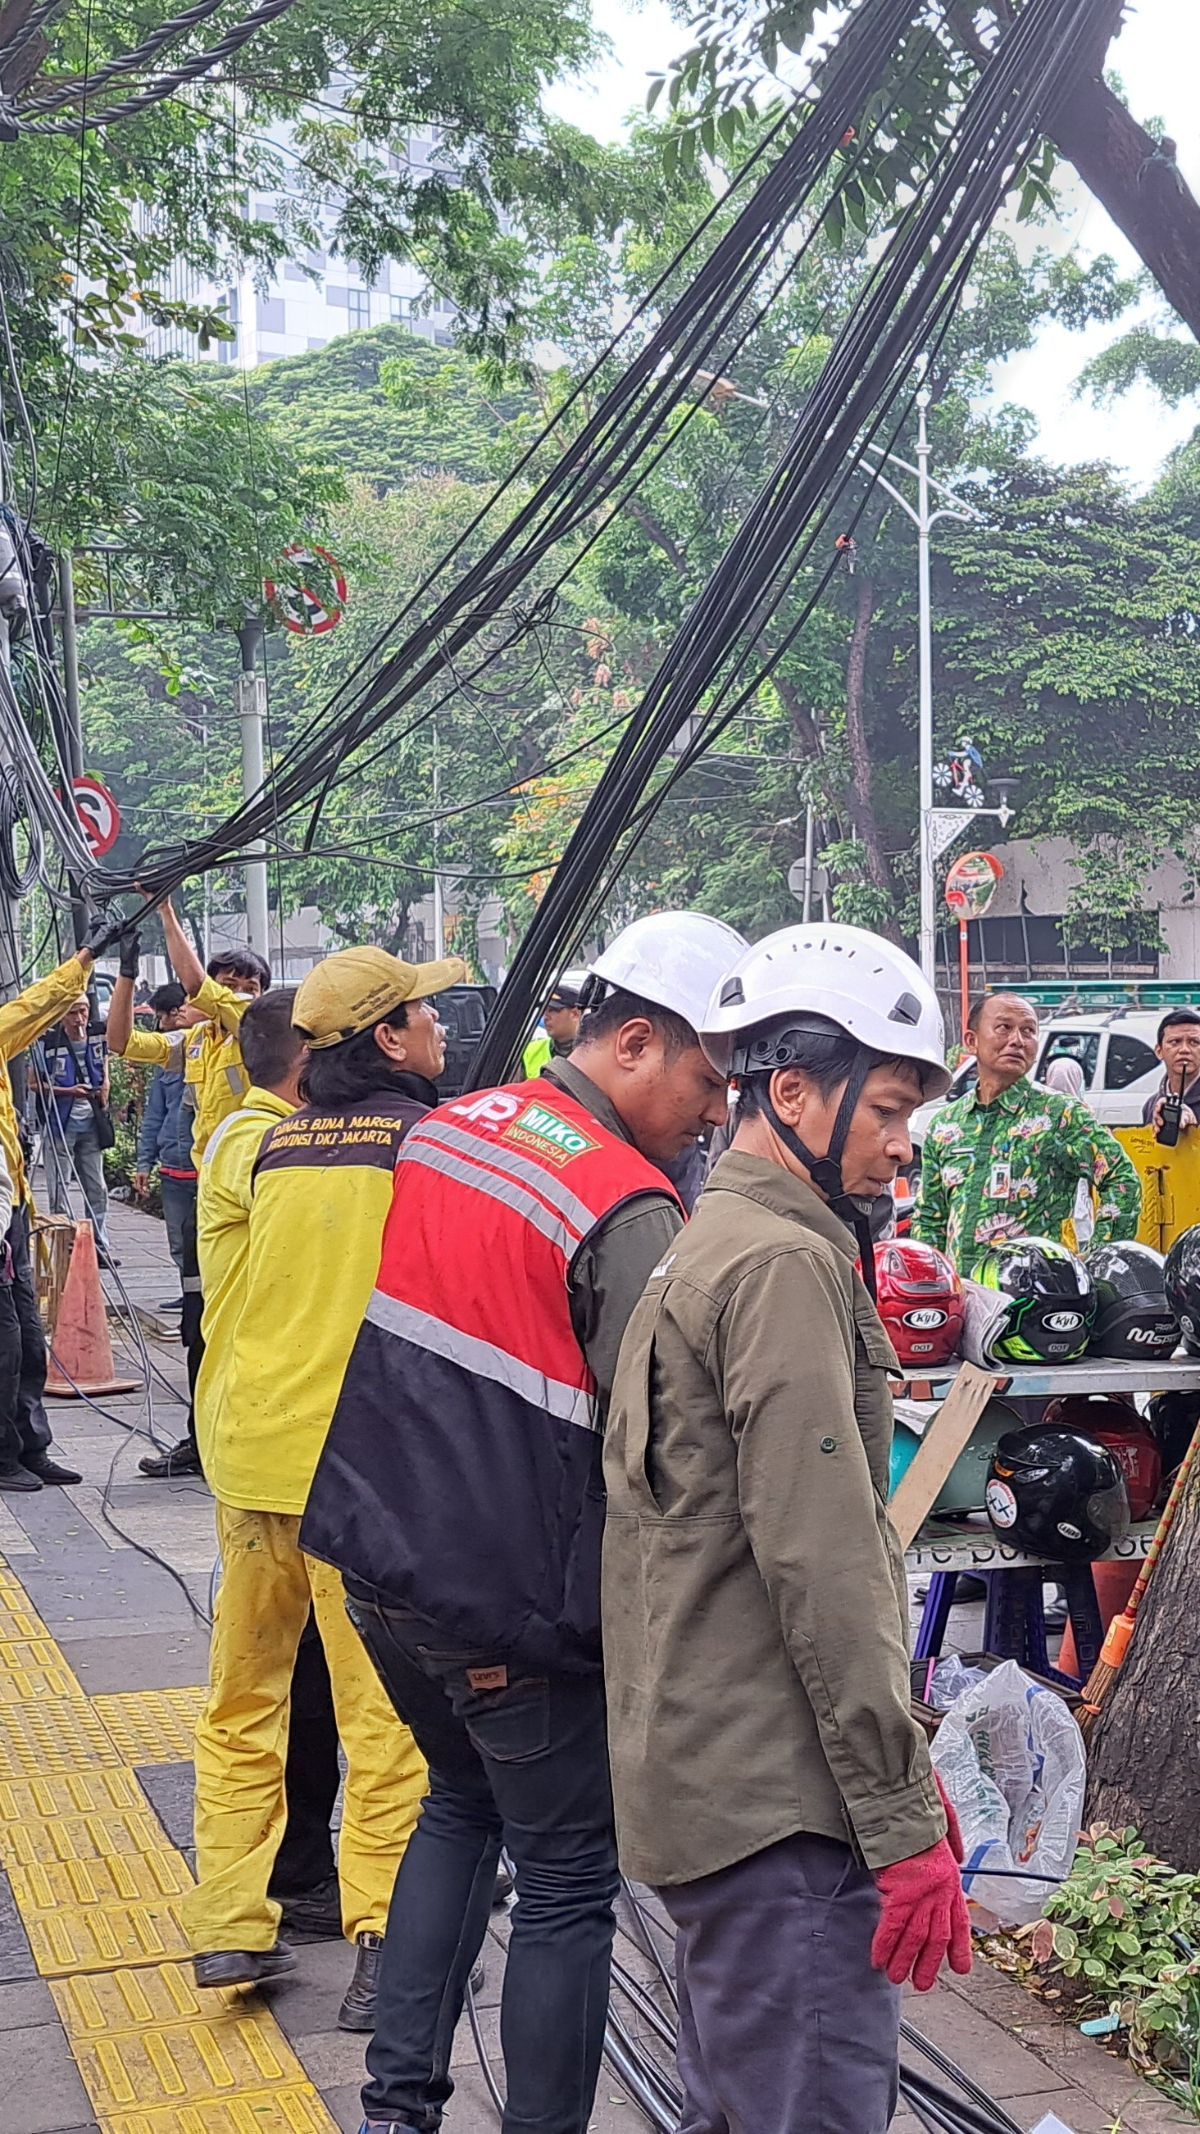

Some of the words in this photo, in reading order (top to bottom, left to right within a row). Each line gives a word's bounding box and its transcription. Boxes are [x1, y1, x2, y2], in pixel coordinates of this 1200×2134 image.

[267, 1132, 313, 1152] PROVINSI
[315, 1132, 337, 1145] DKI
[338, 1129, 392, 1145] JAKARTA
[272, 1119, 309, 1138] DINAS
[310, 1117, 344, 1130] BINA
[349, 1115, 402, 1131] MARGA
[520, 1106, 588, 1152] MIKO
[507, 1127, 570, 1163] INDONESIA
